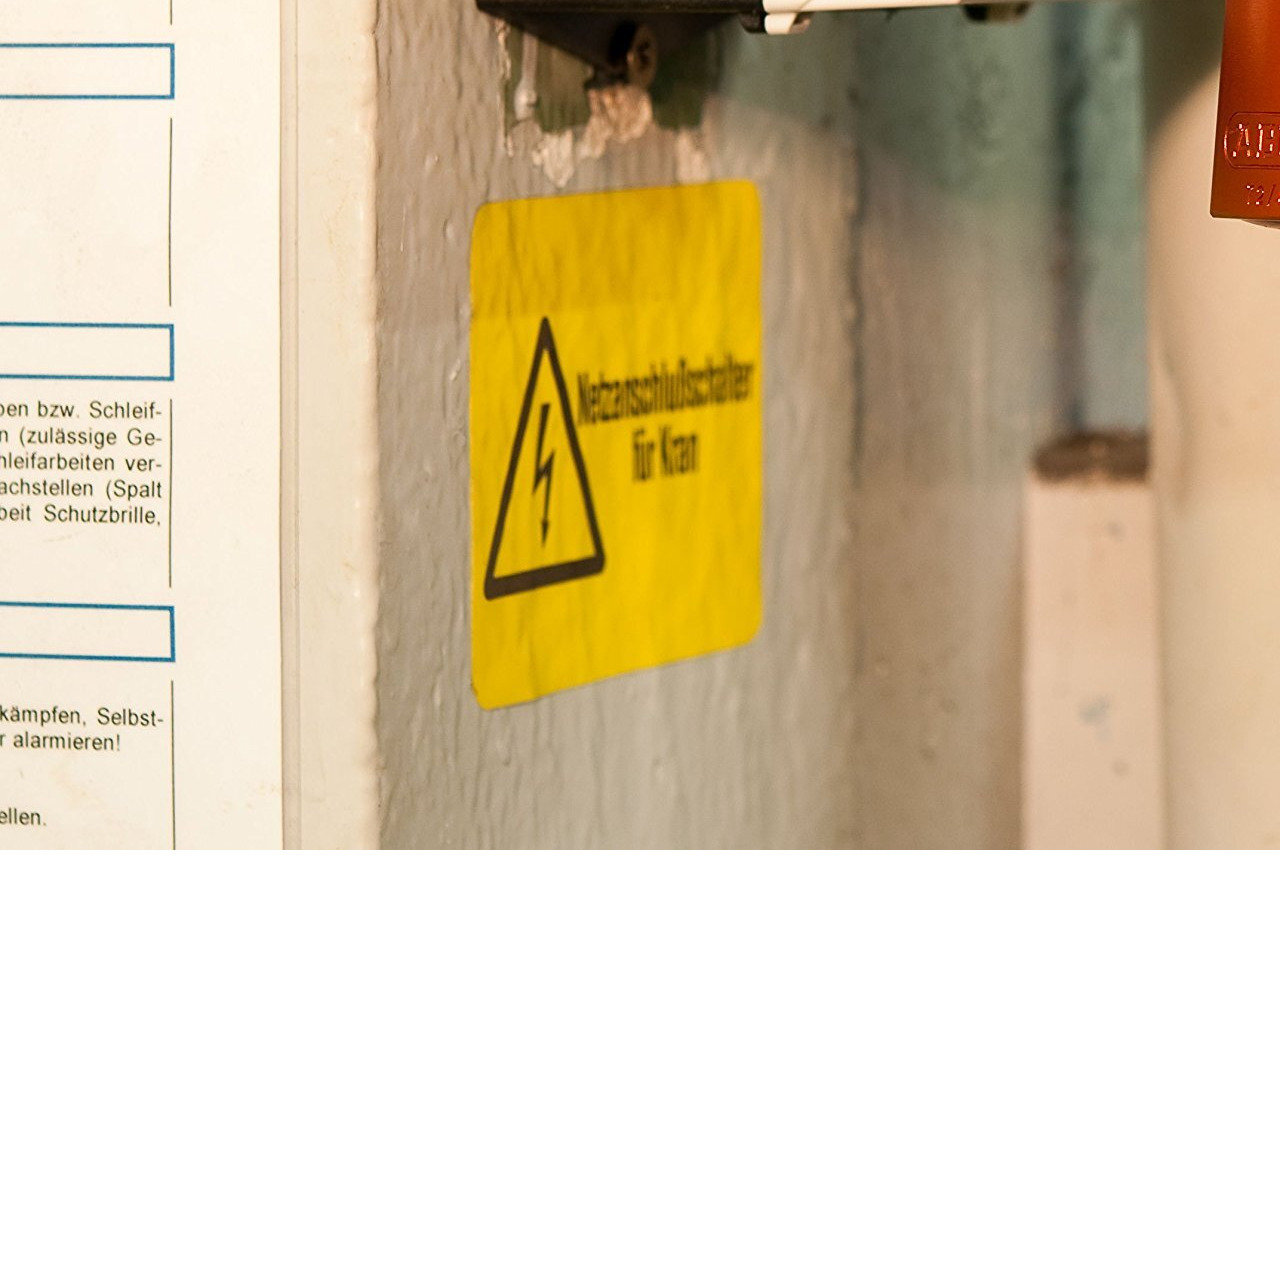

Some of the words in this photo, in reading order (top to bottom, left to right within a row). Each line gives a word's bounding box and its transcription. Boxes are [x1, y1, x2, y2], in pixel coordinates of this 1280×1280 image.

[38, 400, 80, 418] bzw.
[89, 400, 162, 420] Schleif-
[19, 426, 117, 450] (zulässige
[127, 427, 162, 446] Ge-
[125, 458, 162, 471] ver-
[105, 479, 162, 502] (Spalt
[44, 503, 160, 527] Schutzbrille,
[0, 705, 86, 727] kämpfen,
[97, 706, 164, 727] Selbst-
[13, 731, 120, 752] alarmieren!
